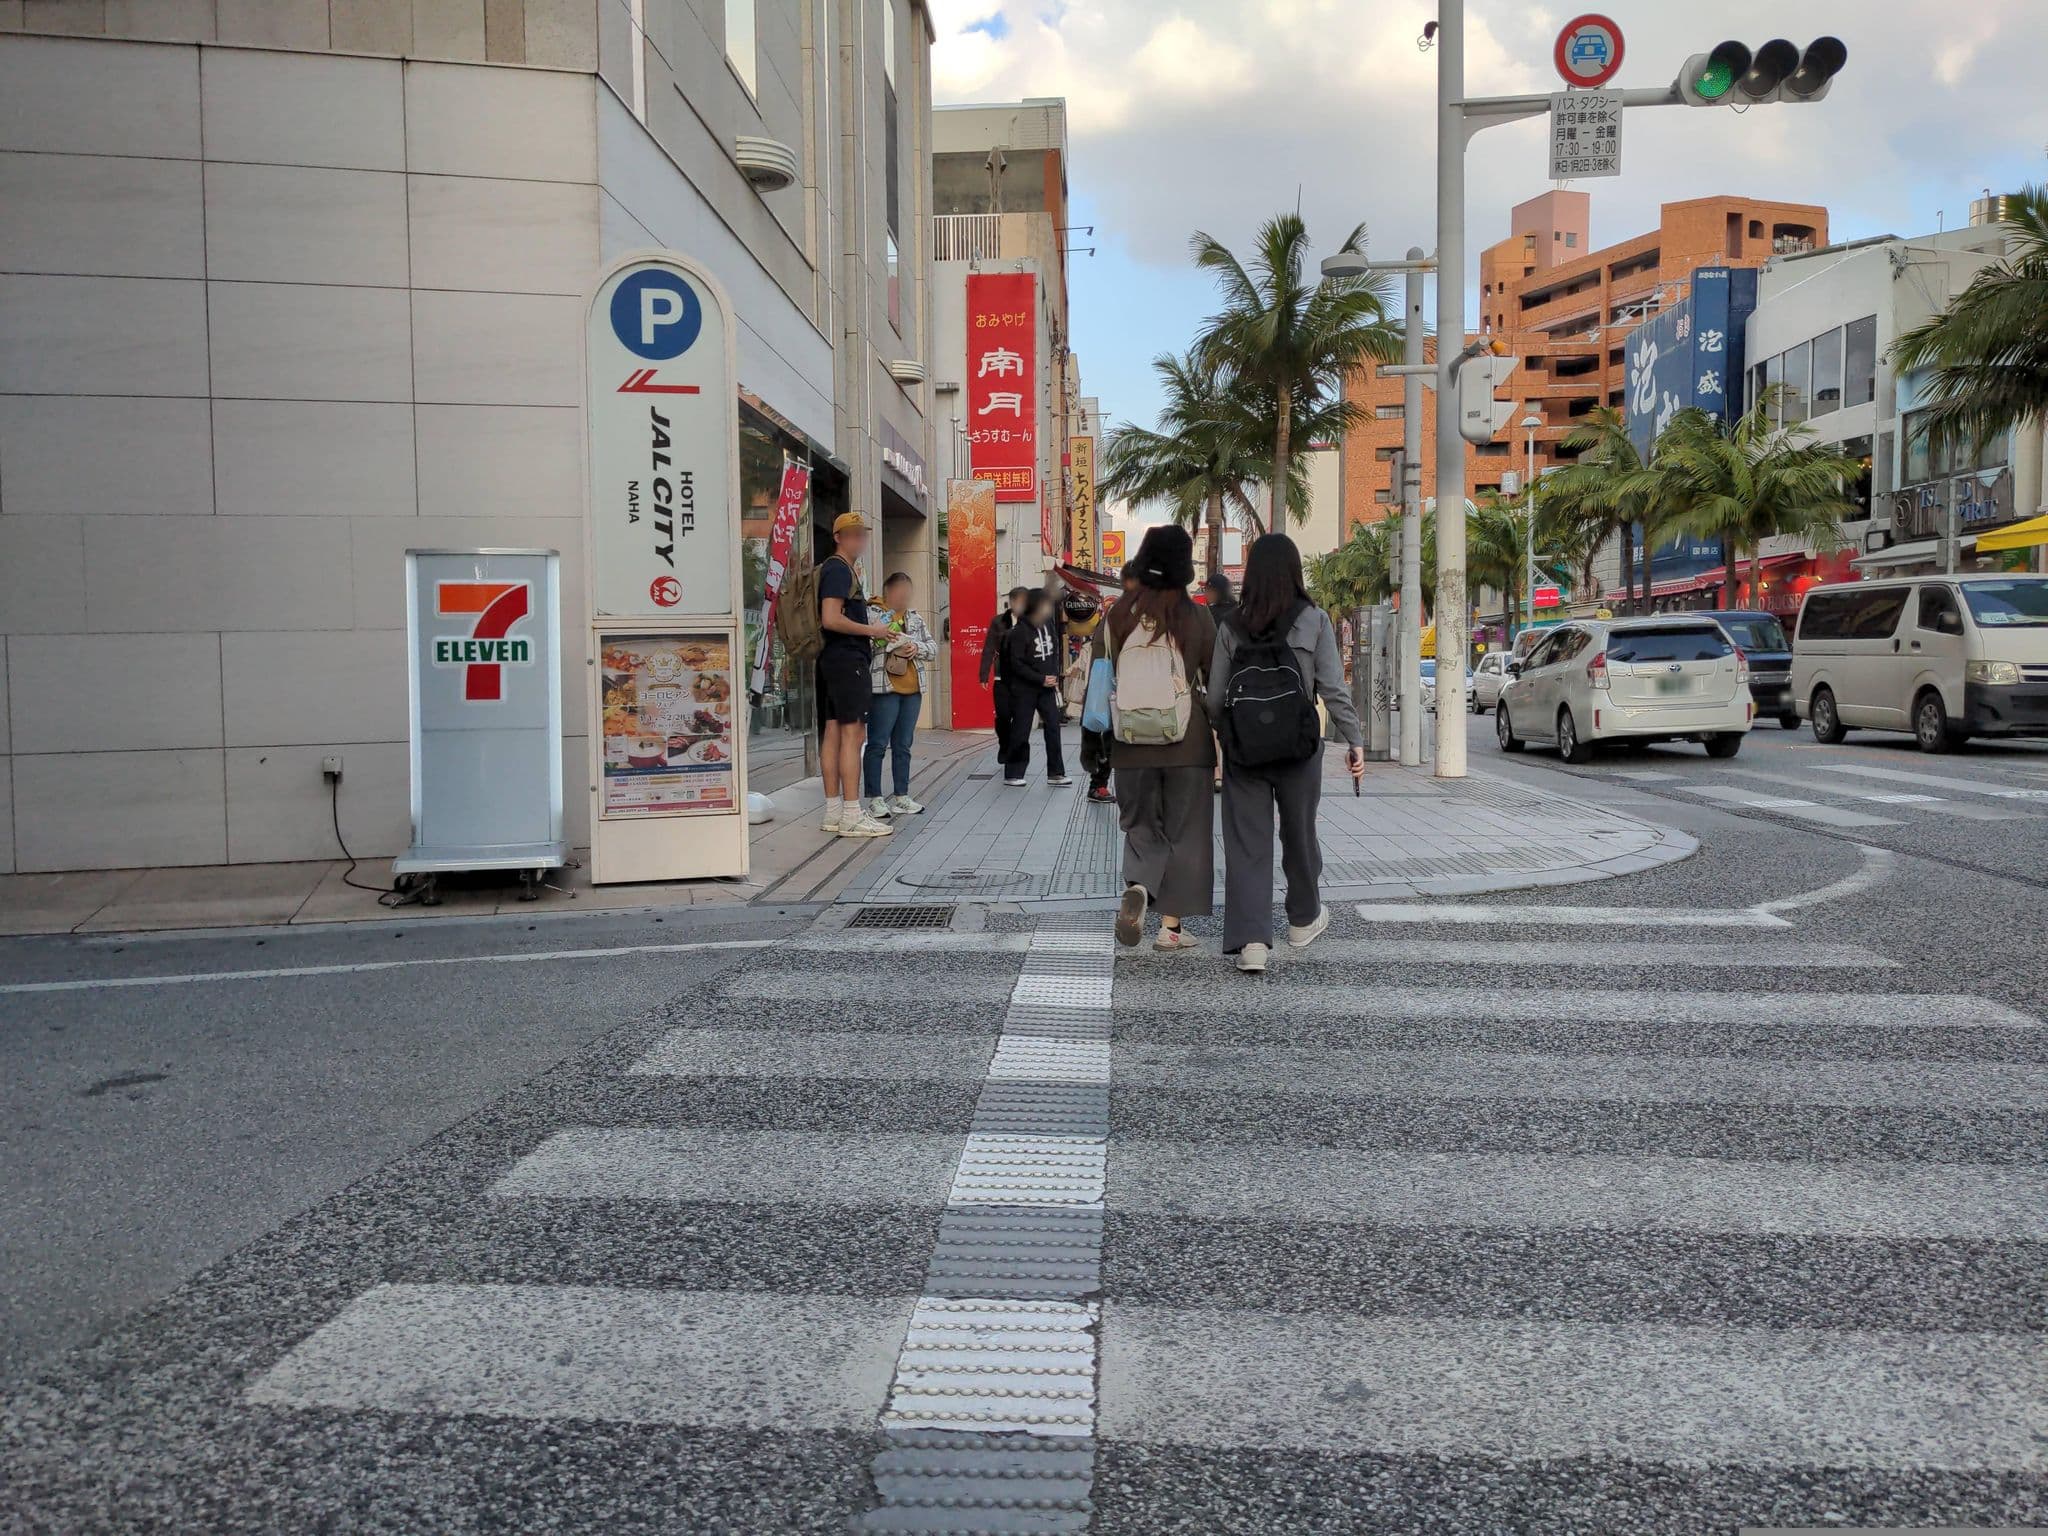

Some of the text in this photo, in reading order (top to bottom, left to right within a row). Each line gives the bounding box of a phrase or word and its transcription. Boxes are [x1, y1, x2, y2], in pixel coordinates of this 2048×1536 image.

[1556, 110, 1617, 126] 許可車を除く
[640, 288, 684, 345] P
[975, 312, 1026, 328] おみやげ
[977, 346, 1024, 418] 南月
[972, 429, 1032, 443] さうすむーん
[628, 480, 640, 524] NAHA
[680, 471, 694, 537] HOTEL
[1066, 601, 1095, 609] GUINNESS
